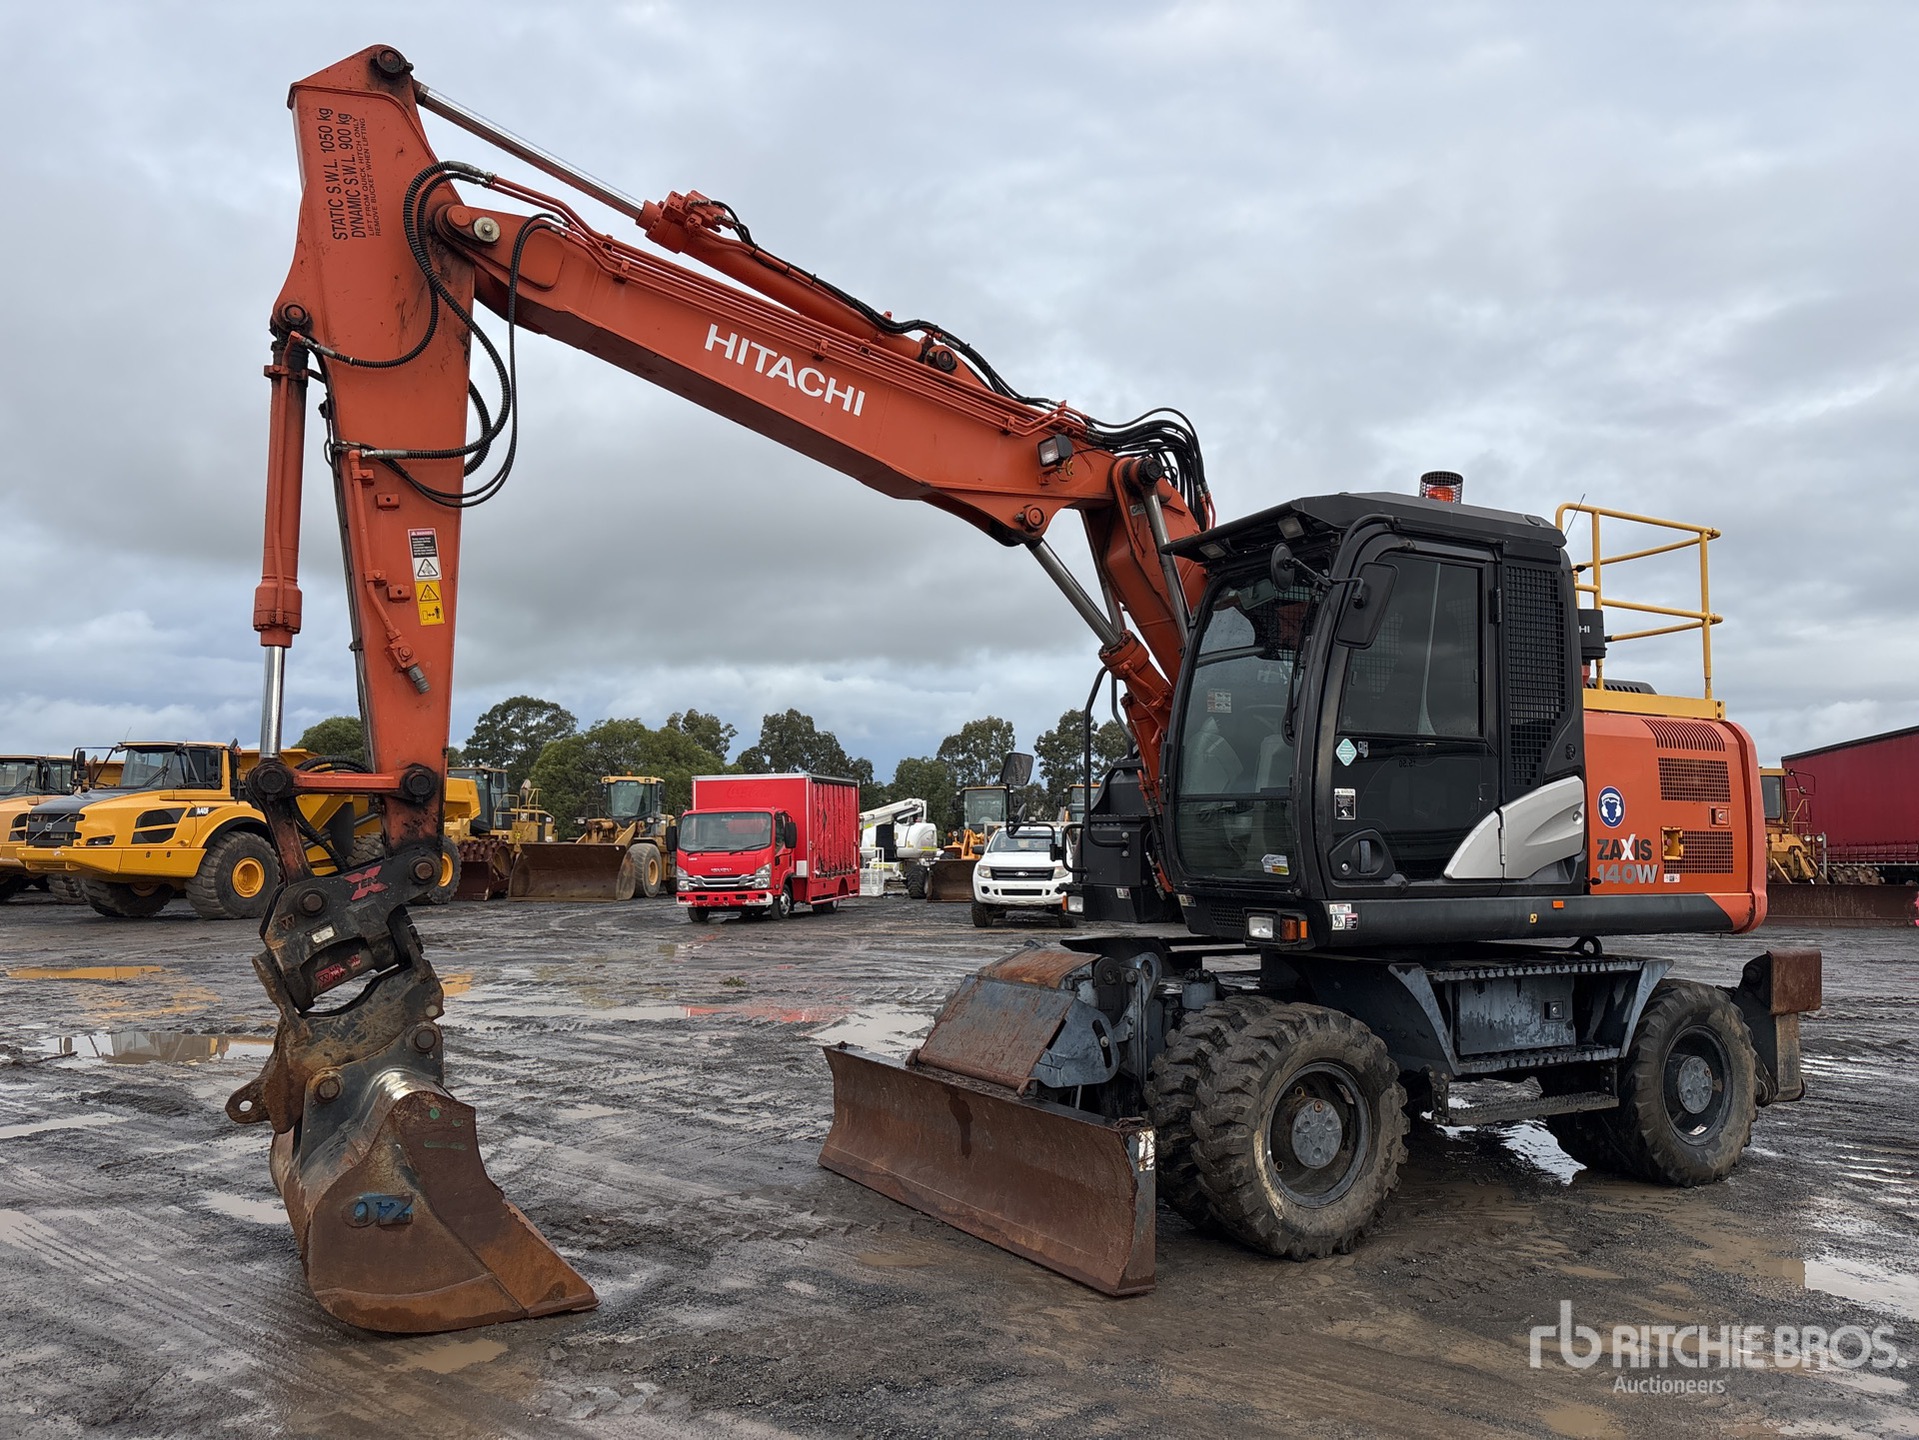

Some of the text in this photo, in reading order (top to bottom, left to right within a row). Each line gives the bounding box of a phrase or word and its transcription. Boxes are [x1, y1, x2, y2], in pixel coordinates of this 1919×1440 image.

[317, 108, 348, 240] STATIC S.W.L. 1050 kg
[336, 113, 366, 239] DYNAMIC S.W.L. 900 kg
[352, 117, 375, 236] LIFT FROM QUICK HITCH ONLY
[359, 118, 381, 237] REMOVE BUCKET WHEN LIFTING
[704, 323, 866, 417] HITACHI
[1597, 834, 1652, 861] ZAXIS
[1597, 864, 1659, 884] 140W
